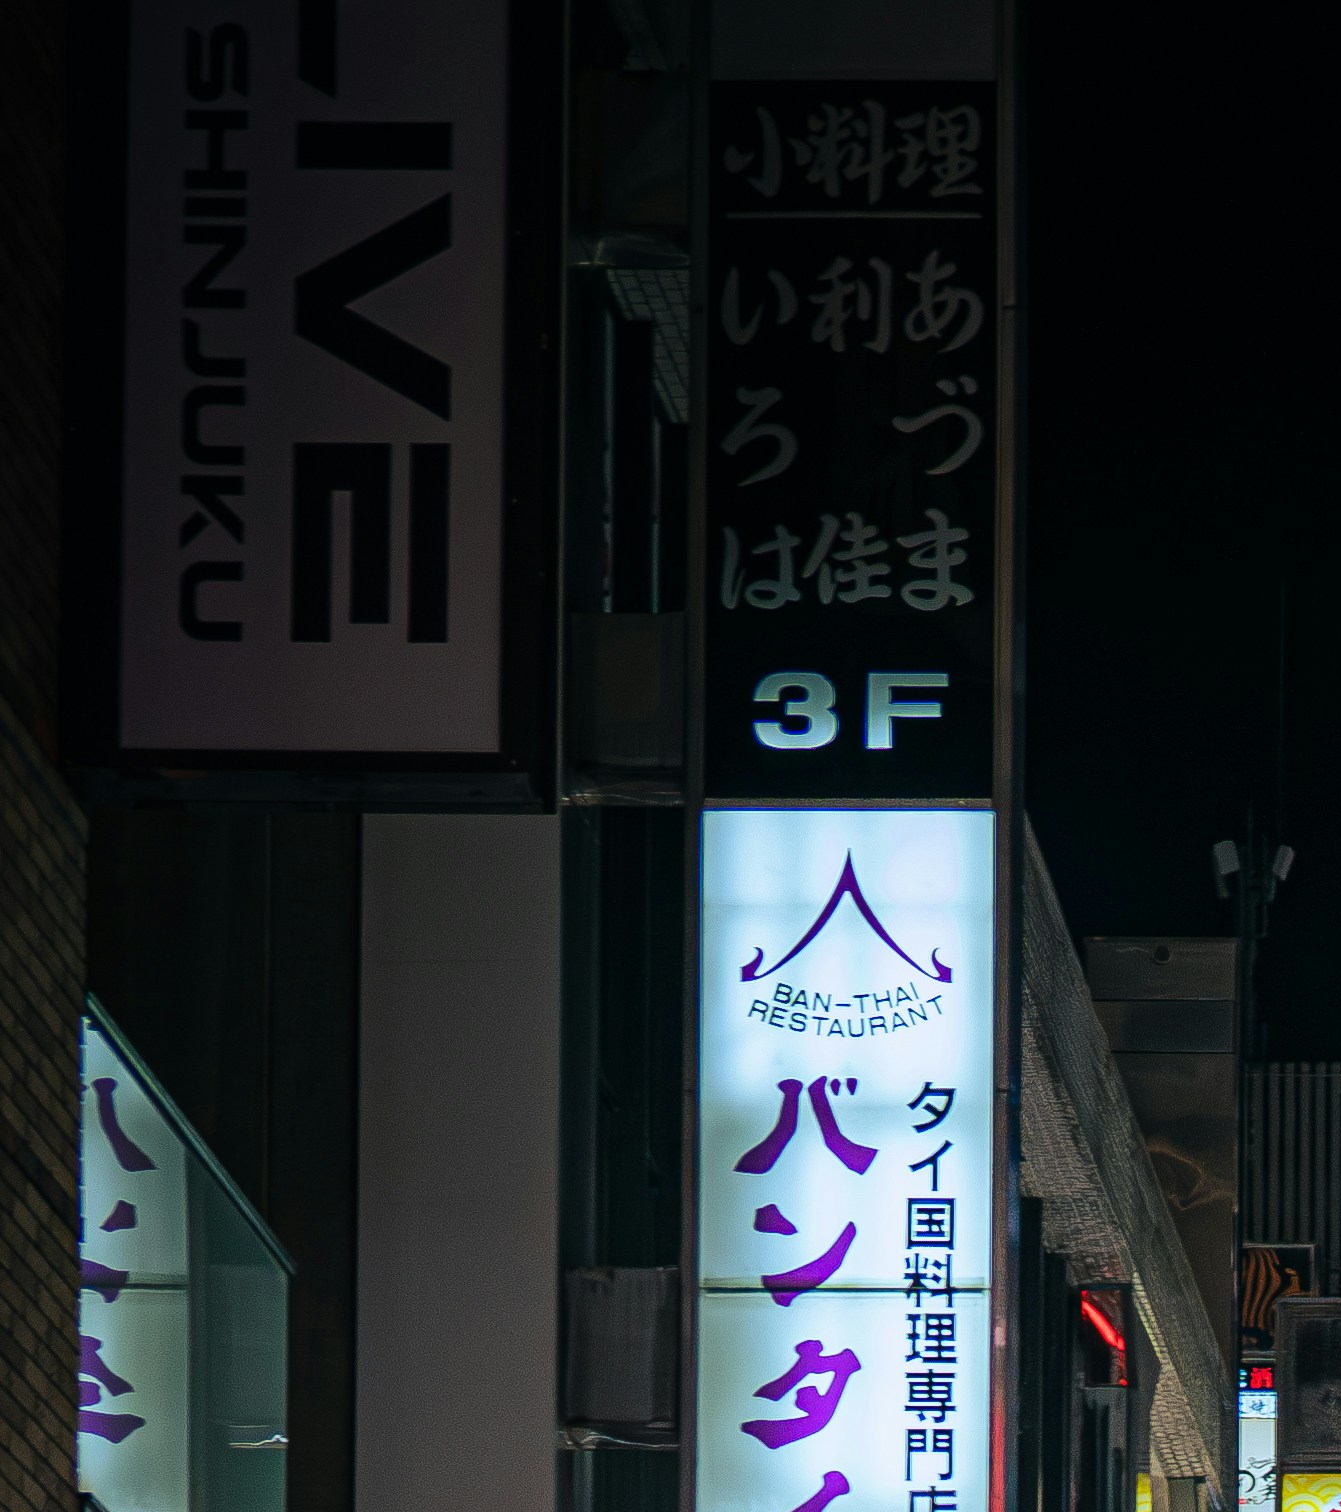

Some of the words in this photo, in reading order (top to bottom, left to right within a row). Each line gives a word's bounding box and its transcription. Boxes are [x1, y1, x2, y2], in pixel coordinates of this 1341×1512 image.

[723, 100, 982, 206] 小料理
[179, 21, 249, 643] SHINJUKU
[720, 265, 799, 610] いろは
[892, 249, 982, 612] あづま
[752, 672, 949, 750] 3F
[748, 997, 947, 1039] RESTAURANT
[772, 981, 921, 1013] BAN-THAI
